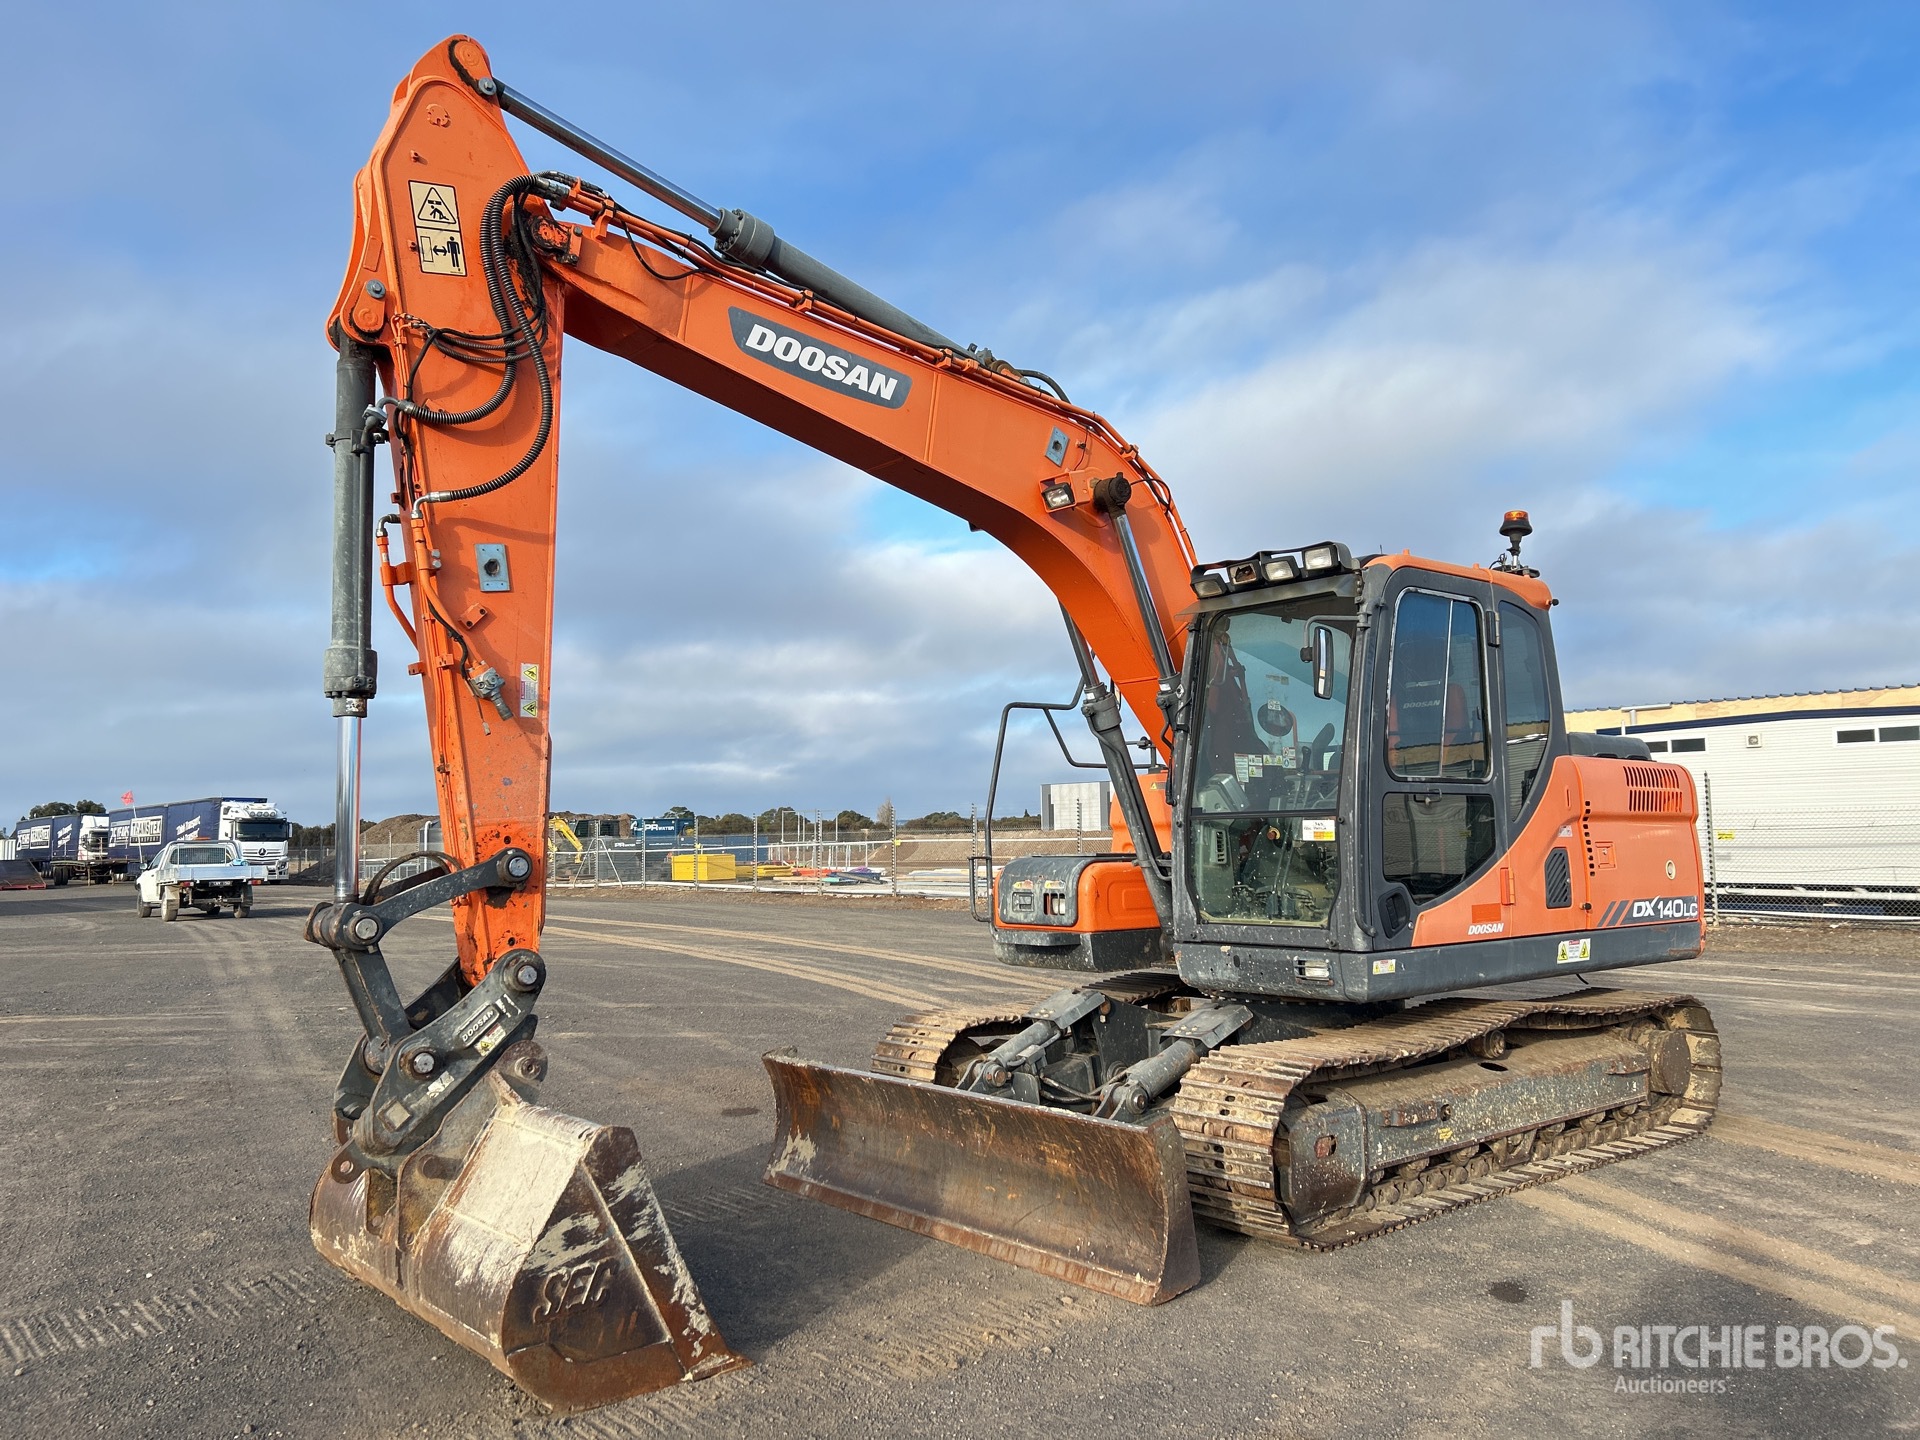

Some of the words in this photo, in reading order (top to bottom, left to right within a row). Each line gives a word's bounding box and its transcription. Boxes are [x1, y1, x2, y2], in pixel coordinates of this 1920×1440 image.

[745, 323, 898, 401] DOOSAN
[1403, 699, 1440, 709] DOOSAN
[132, 820, 161, 836] TRANSTEX
[1467, 922, 1504, 936] DOOSAN
[462, 1010, 494, 1043] DOOSAN
